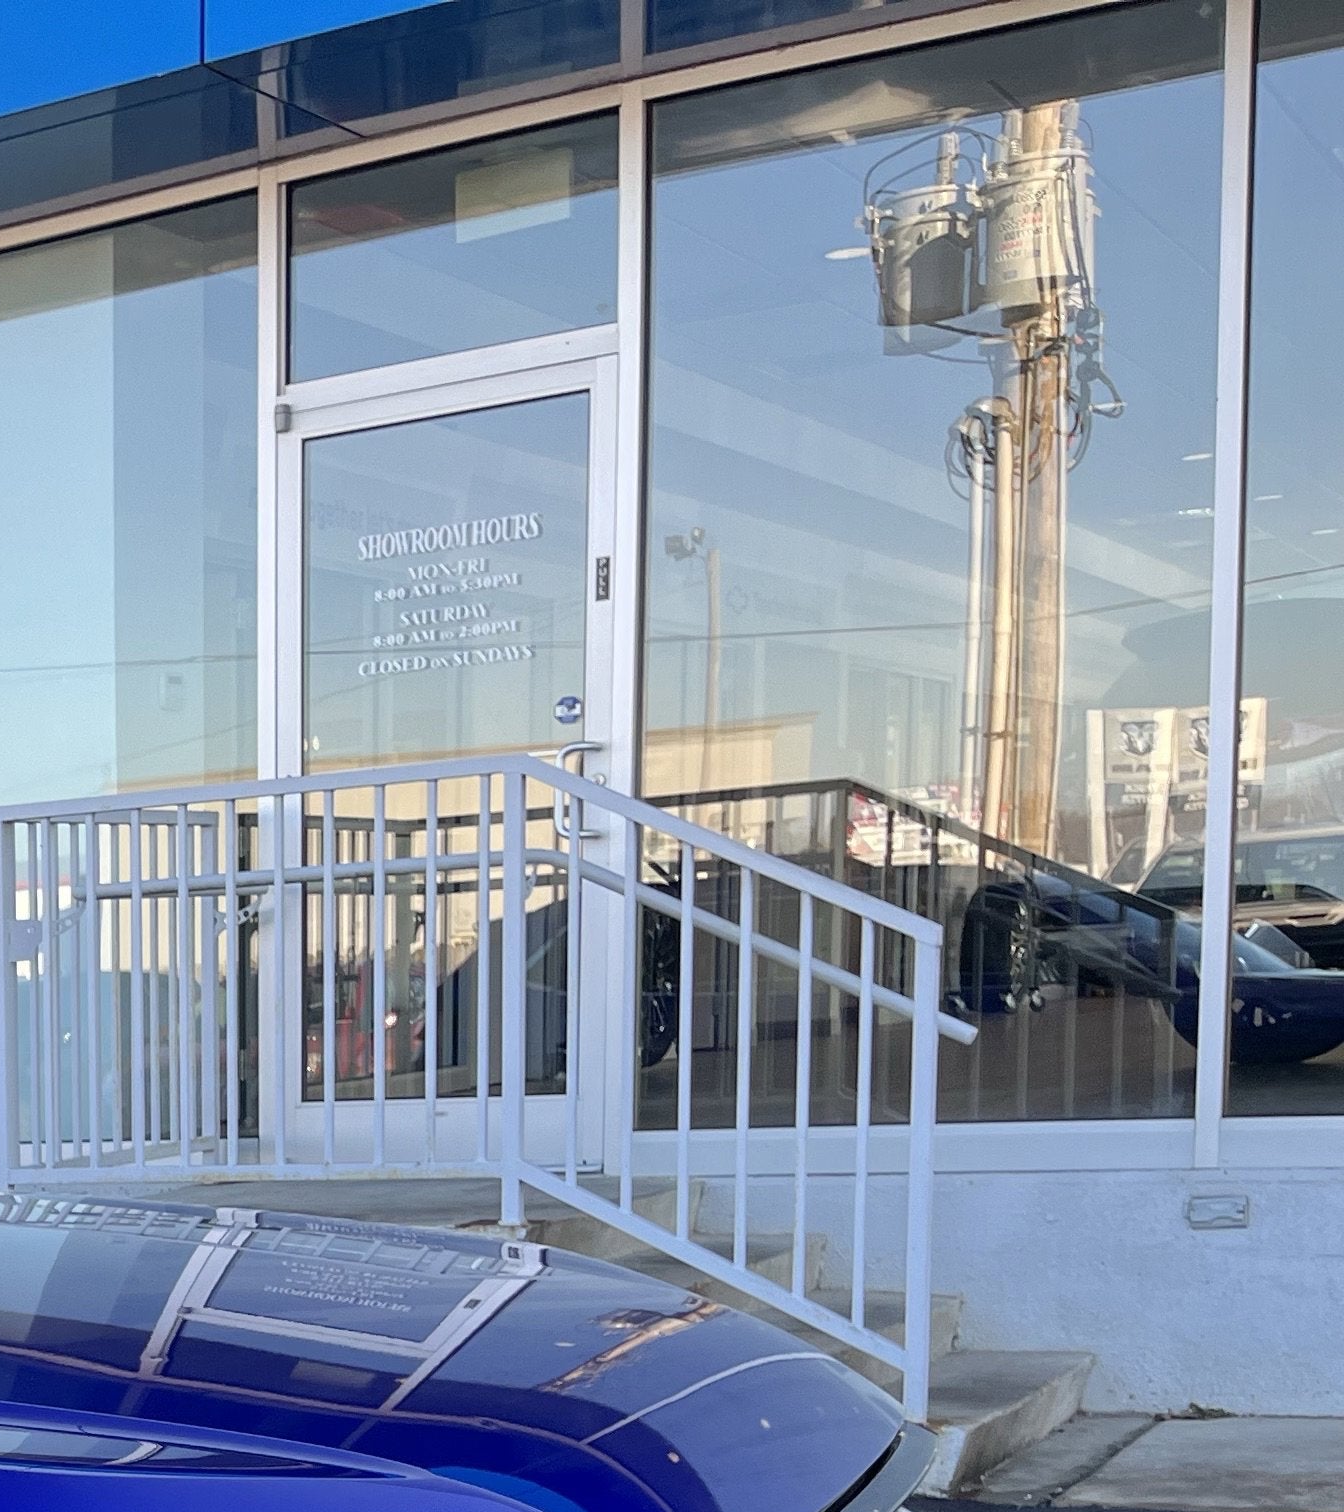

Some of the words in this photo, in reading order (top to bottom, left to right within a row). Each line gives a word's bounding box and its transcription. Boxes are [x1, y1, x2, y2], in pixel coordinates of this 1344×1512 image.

[358, 522, 467, 560] SHOWROOM
[471, 512, 541, 546] HOURS
[408, 557, 487, 580] MON-FRI
[598, 558, 608, 596] PULL
[374, 586, 405, 602] 8:00
[410, 583, 437, 598] AM
[400, 602, 490, 627] SATURDAY
[373, 633, 404, 648] 8:00
[410, 629, 436, 643] AM
[459, 619, 518, 638] 2:00PM
[358, 655, 427, 677] CLOSED
[453, 644, 534, 666] SUNDAYS
